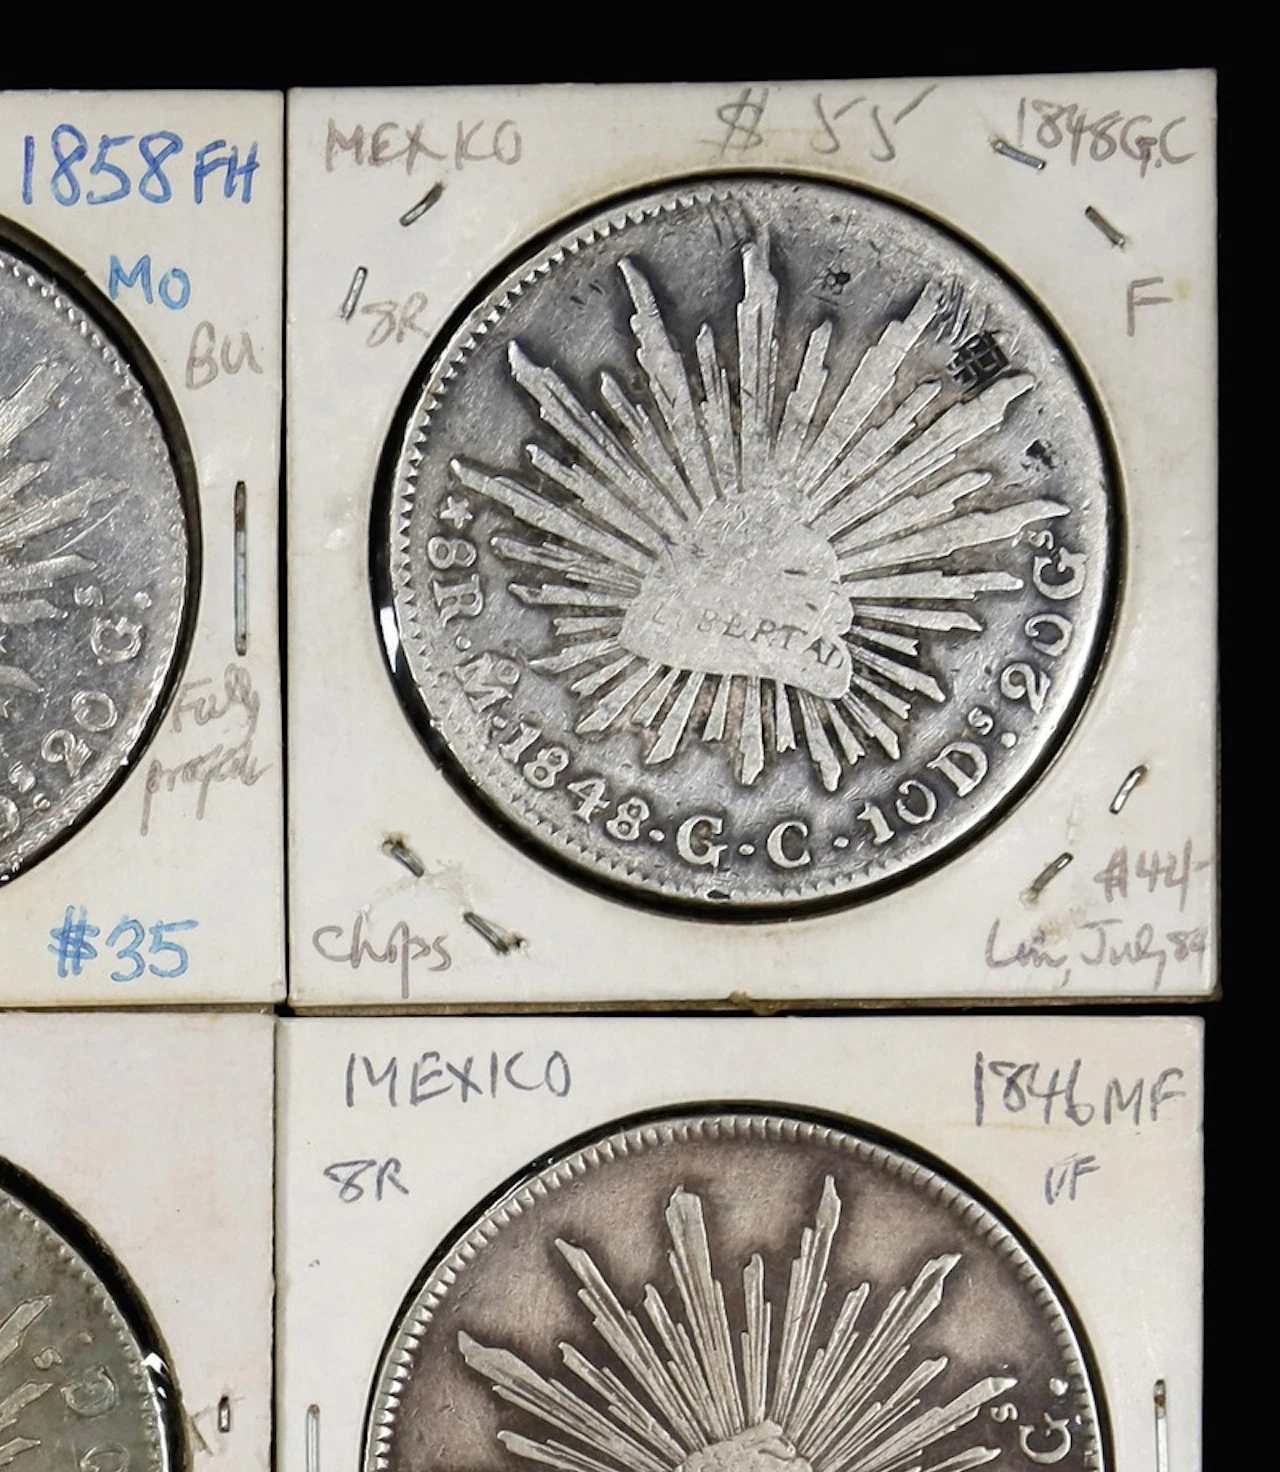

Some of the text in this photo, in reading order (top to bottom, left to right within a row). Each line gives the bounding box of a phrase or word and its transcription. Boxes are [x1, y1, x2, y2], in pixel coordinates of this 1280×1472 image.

[361, 290, 432, 349] 8R
[1126, 274, 1174, 337] F
[187, 321, 265, 388] BU
[46, 904, 199, 984] $35
[346, 1050, 573, 1110] MEXICO
[325, 1158, 410, 1202] 8R
